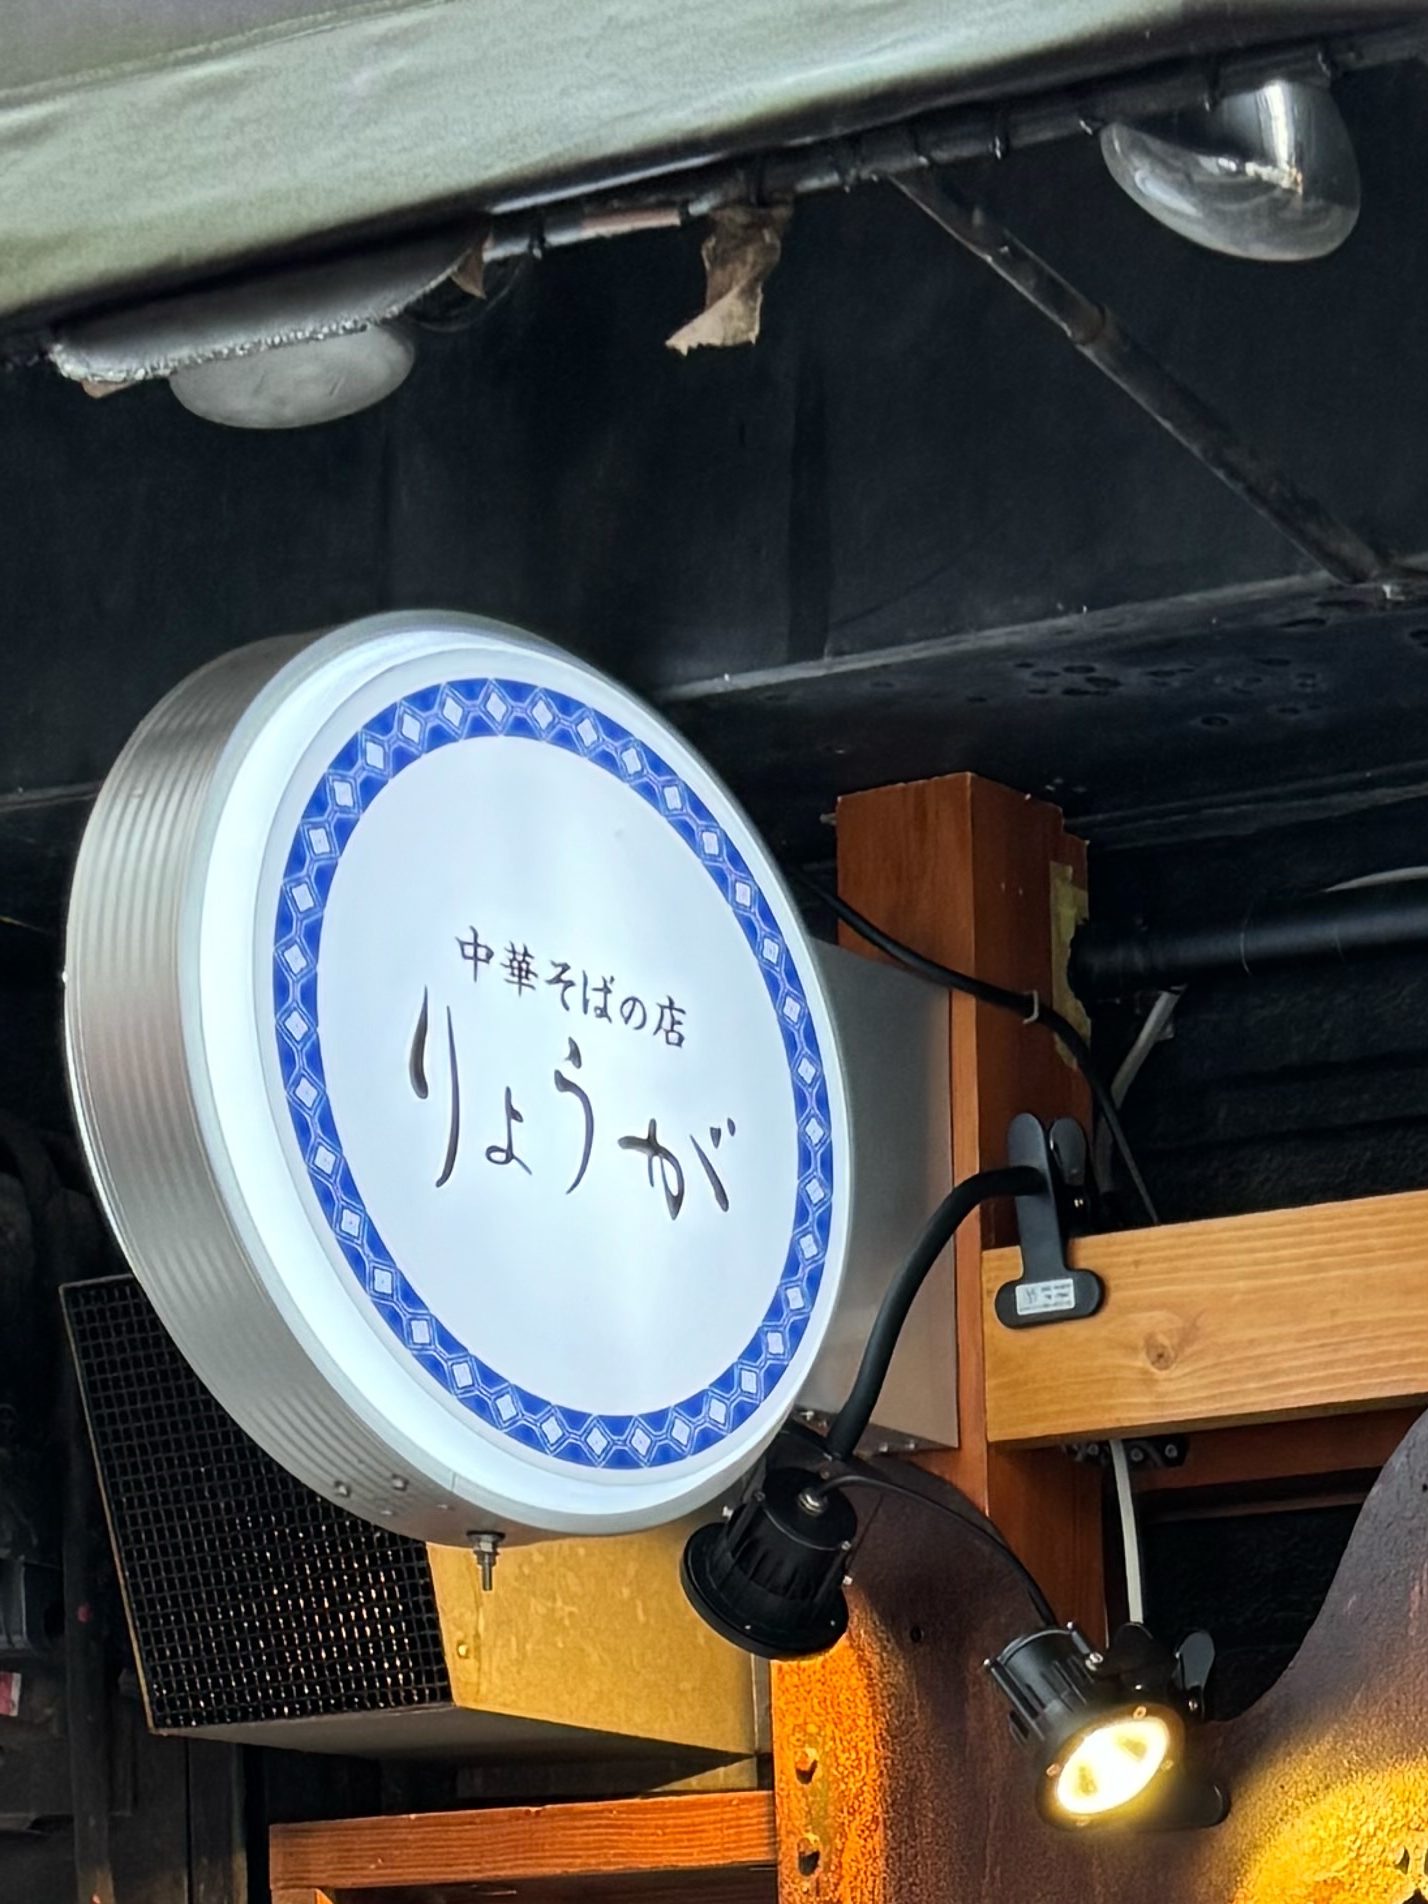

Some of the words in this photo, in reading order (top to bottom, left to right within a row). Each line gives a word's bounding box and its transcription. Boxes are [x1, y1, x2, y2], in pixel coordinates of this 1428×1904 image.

[454, 925, 687, 1048] 中華そばの店
[409, 984, 737, 1221] りょうが
